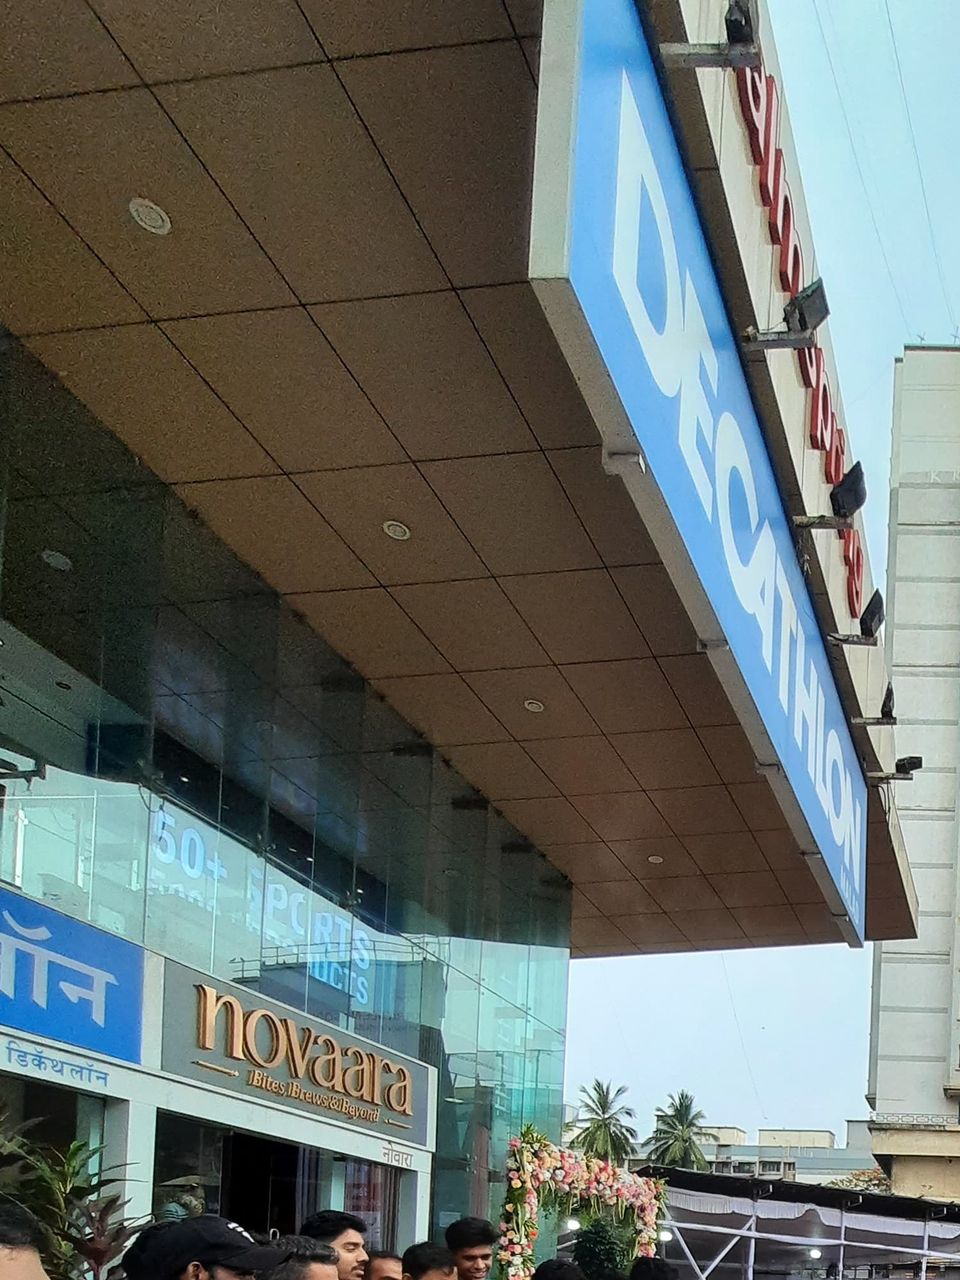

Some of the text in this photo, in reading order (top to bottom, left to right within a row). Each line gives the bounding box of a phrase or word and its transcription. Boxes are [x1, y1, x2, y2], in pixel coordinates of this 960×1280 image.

[612, 69, 861, 894] DECATHLON
[152, 810, 228, 880] 50+
[193, 984, 414, 1116] novaara
